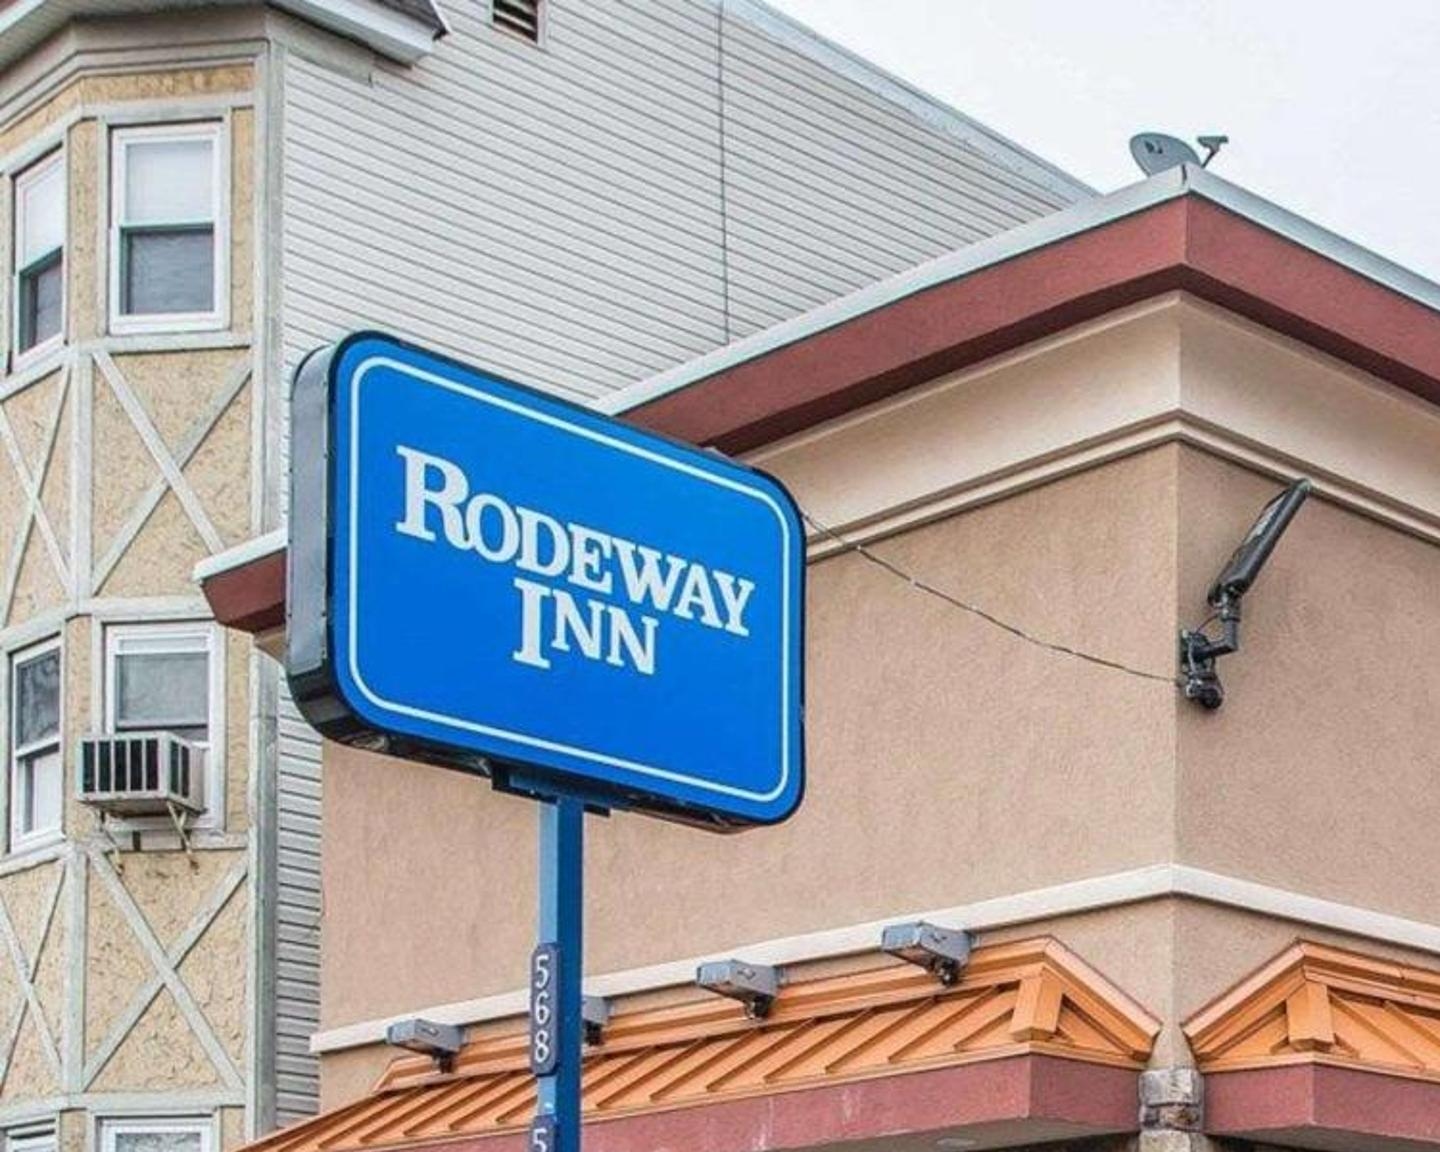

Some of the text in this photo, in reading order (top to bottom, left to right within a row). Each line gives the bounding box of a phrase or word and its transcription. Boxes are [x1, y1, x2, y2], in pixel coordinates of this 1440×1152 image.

[395, 444, 756, 637] RODEWAY
[511, 577, 660, 676] INN
[534, 954, 551, 1064] 568
